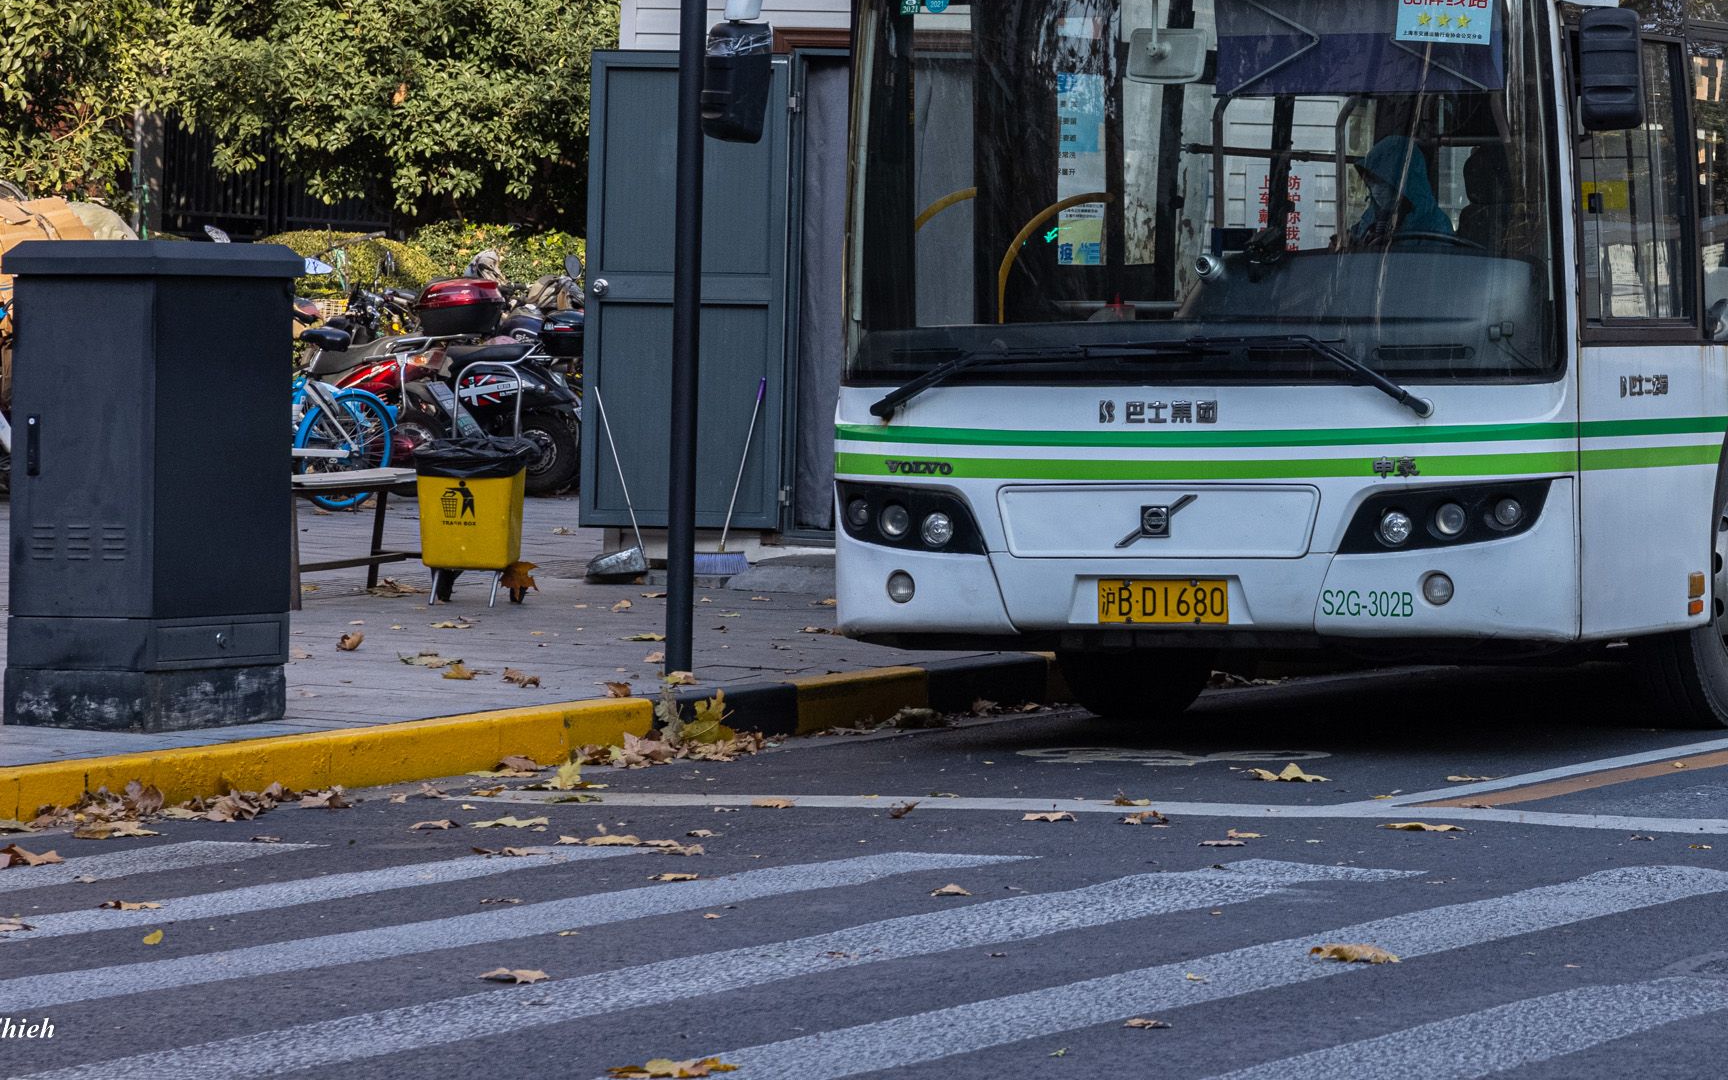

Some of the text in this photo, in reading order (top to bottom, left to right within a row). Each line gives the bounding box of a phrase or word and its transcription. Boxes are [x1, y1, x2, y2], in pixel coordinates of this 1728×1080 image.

[902, 6, 919, 14] 2021
[1126, 399, 1218, 424] 巴士集团
[885, 460, 953, 475] VOLVO
[1322, 589, 1414, 617] S2G-302B
